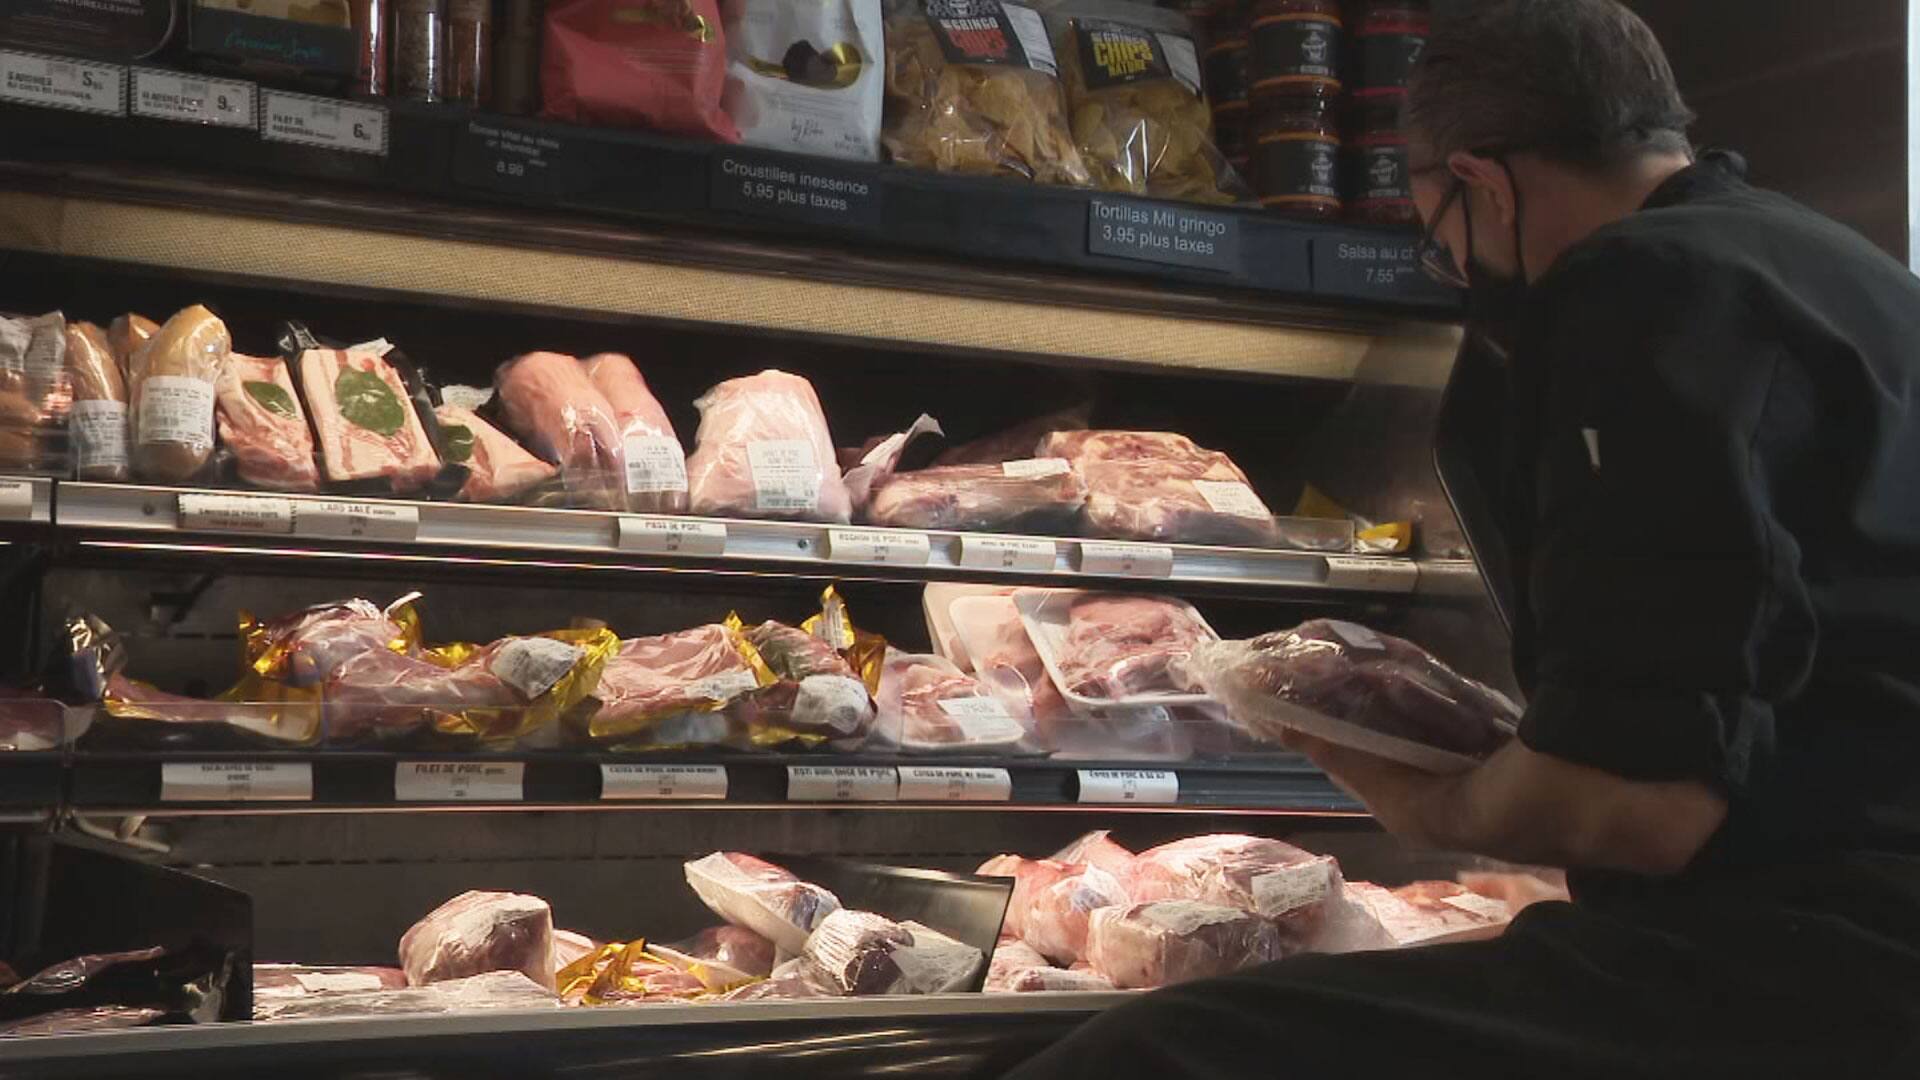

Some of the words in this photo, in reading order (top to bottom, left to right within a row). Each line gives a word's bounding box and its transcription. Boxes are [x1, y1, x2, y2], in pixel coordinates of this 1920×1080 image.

[1093, 41, 1152, 66] CHIPS
[722, 158, 796, 184] Croustilles
[799, 174, 869, 195] inessence
[777, 186, 807, 205] plus
[810, 193, 847, 210] taxes
[1091, 200, 1149, 225] Tortillas
[1179, 216, 1226, 237] gringo
[1139, 231, 1170, 249] plus
[1175, 235, 1214, 255] taxes
[1338, 243, 1377, 260] Salsa
[1380, 247, 1397, 260] au
